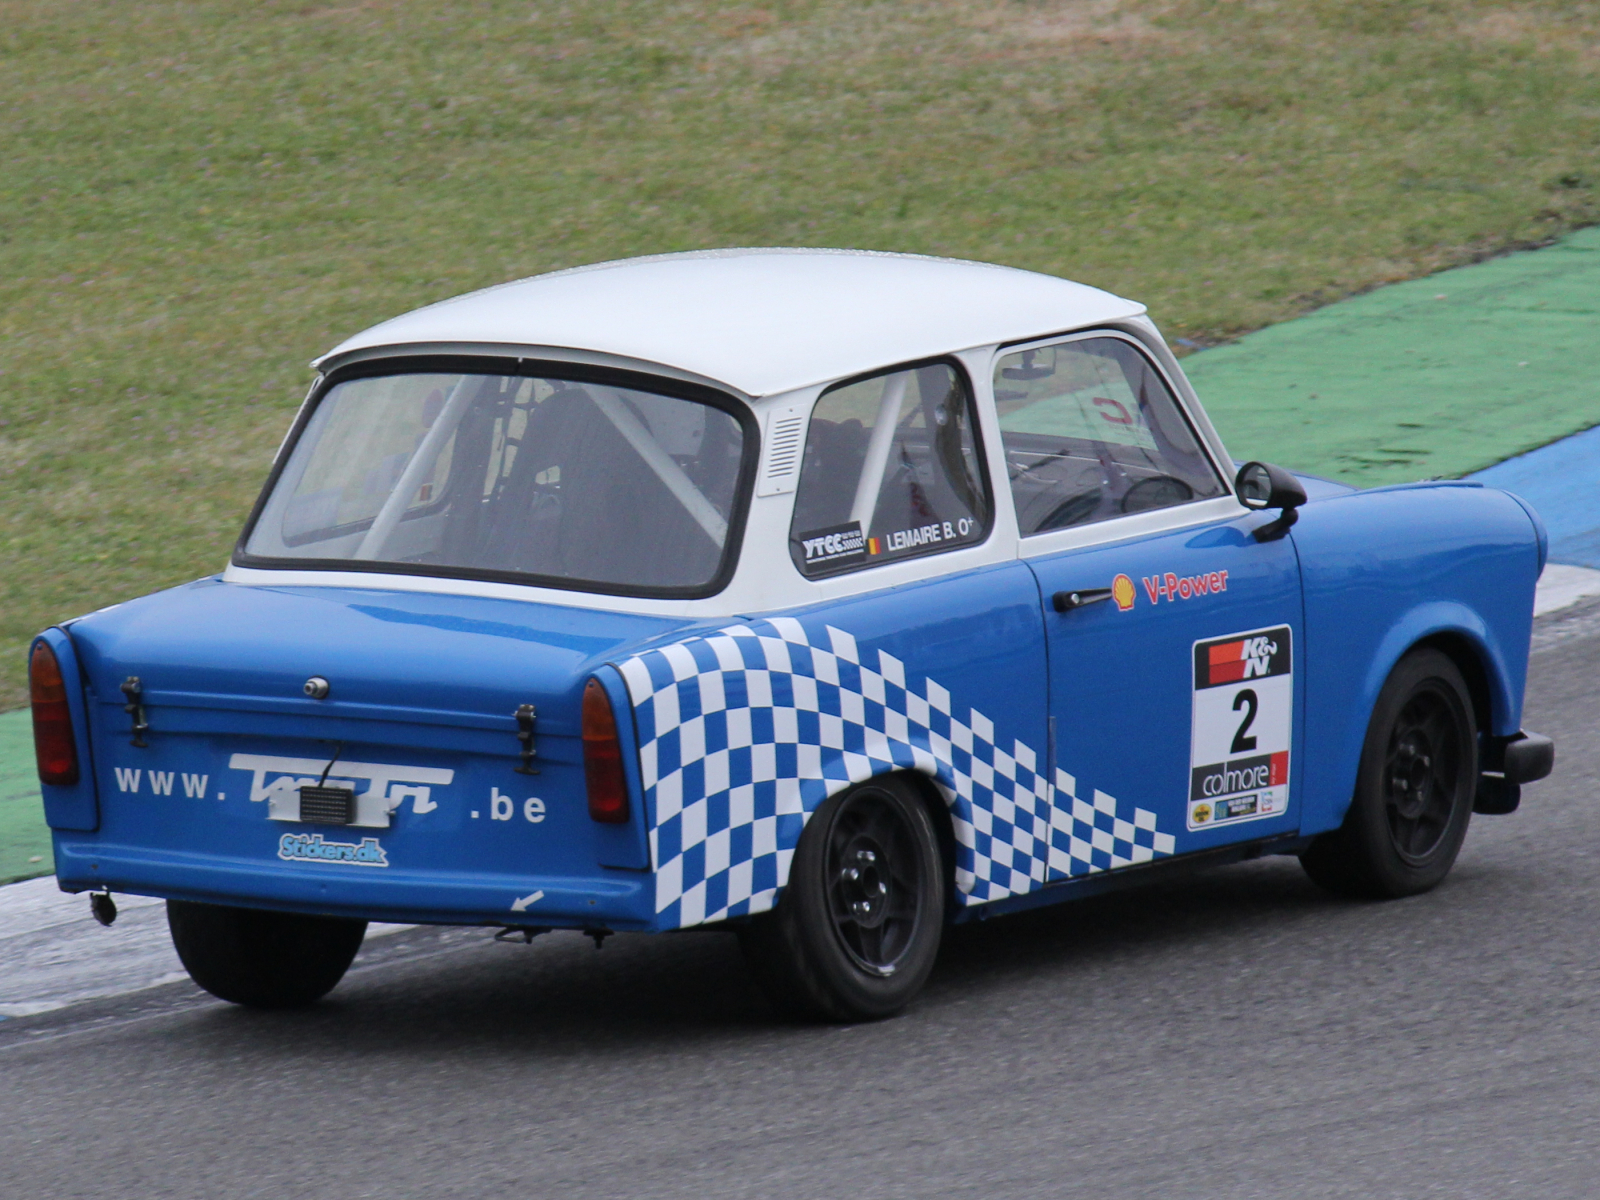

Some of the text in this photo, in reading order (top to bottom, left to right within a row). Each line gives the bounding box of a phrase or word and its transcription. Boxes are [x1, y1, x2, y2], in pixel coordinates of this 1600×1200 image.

[802, 533, 844, 559] YTCC
[886, 523, 941, 552] LEMAIRE
[942, 521, 957, 539] B.
[1142, 569, 1229, 605] V-Power
[1229, 688, 1258, 755] 2
[114, 766, 225, 801] www.
[470, 787, 546, 823] .be
[1202, 761, 1269, 796] colmore
[280, 834, 386, 866] Stickers.dk
